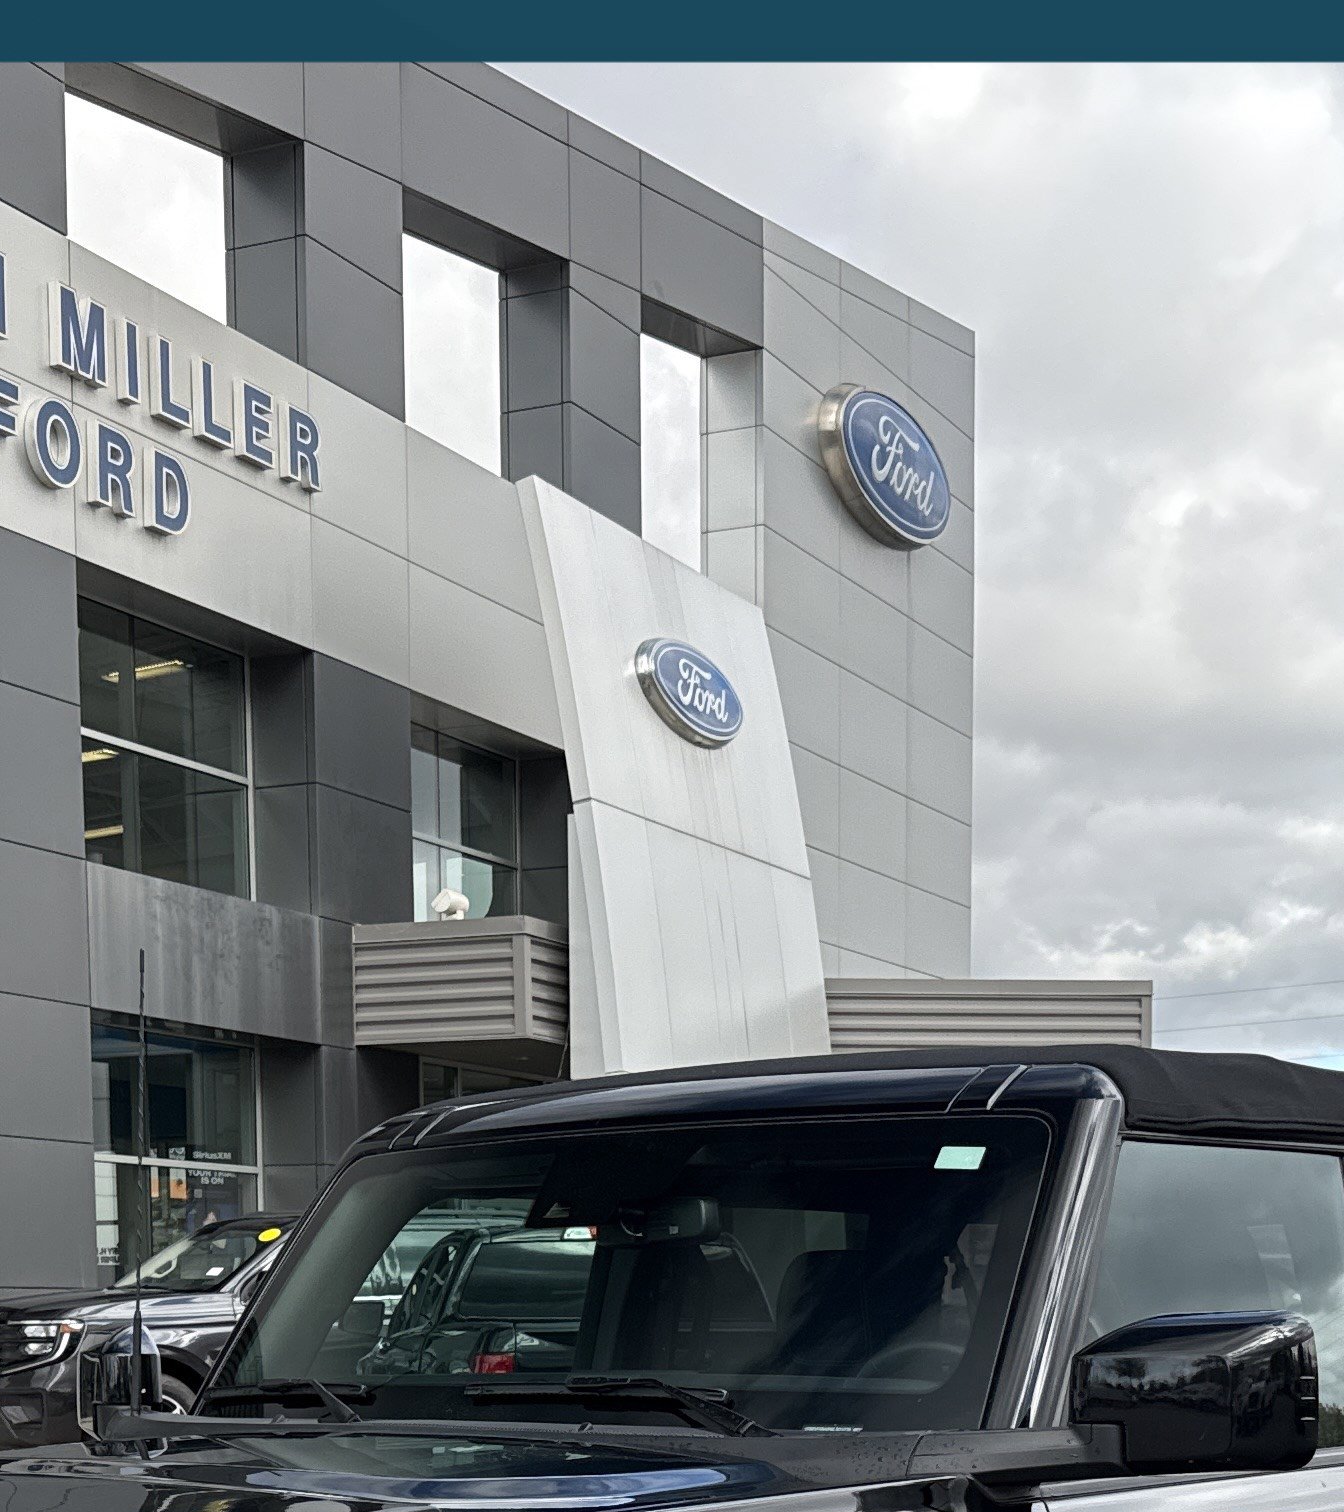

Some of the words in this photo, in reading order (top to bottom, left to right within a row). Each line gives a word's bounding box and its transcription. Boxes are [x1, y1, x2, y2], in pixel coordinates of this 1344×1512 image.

[47, 280, 323, 493] MILLER
[871, 415, 936, 517] Ford
[676, 657, 729, 724] Ford
